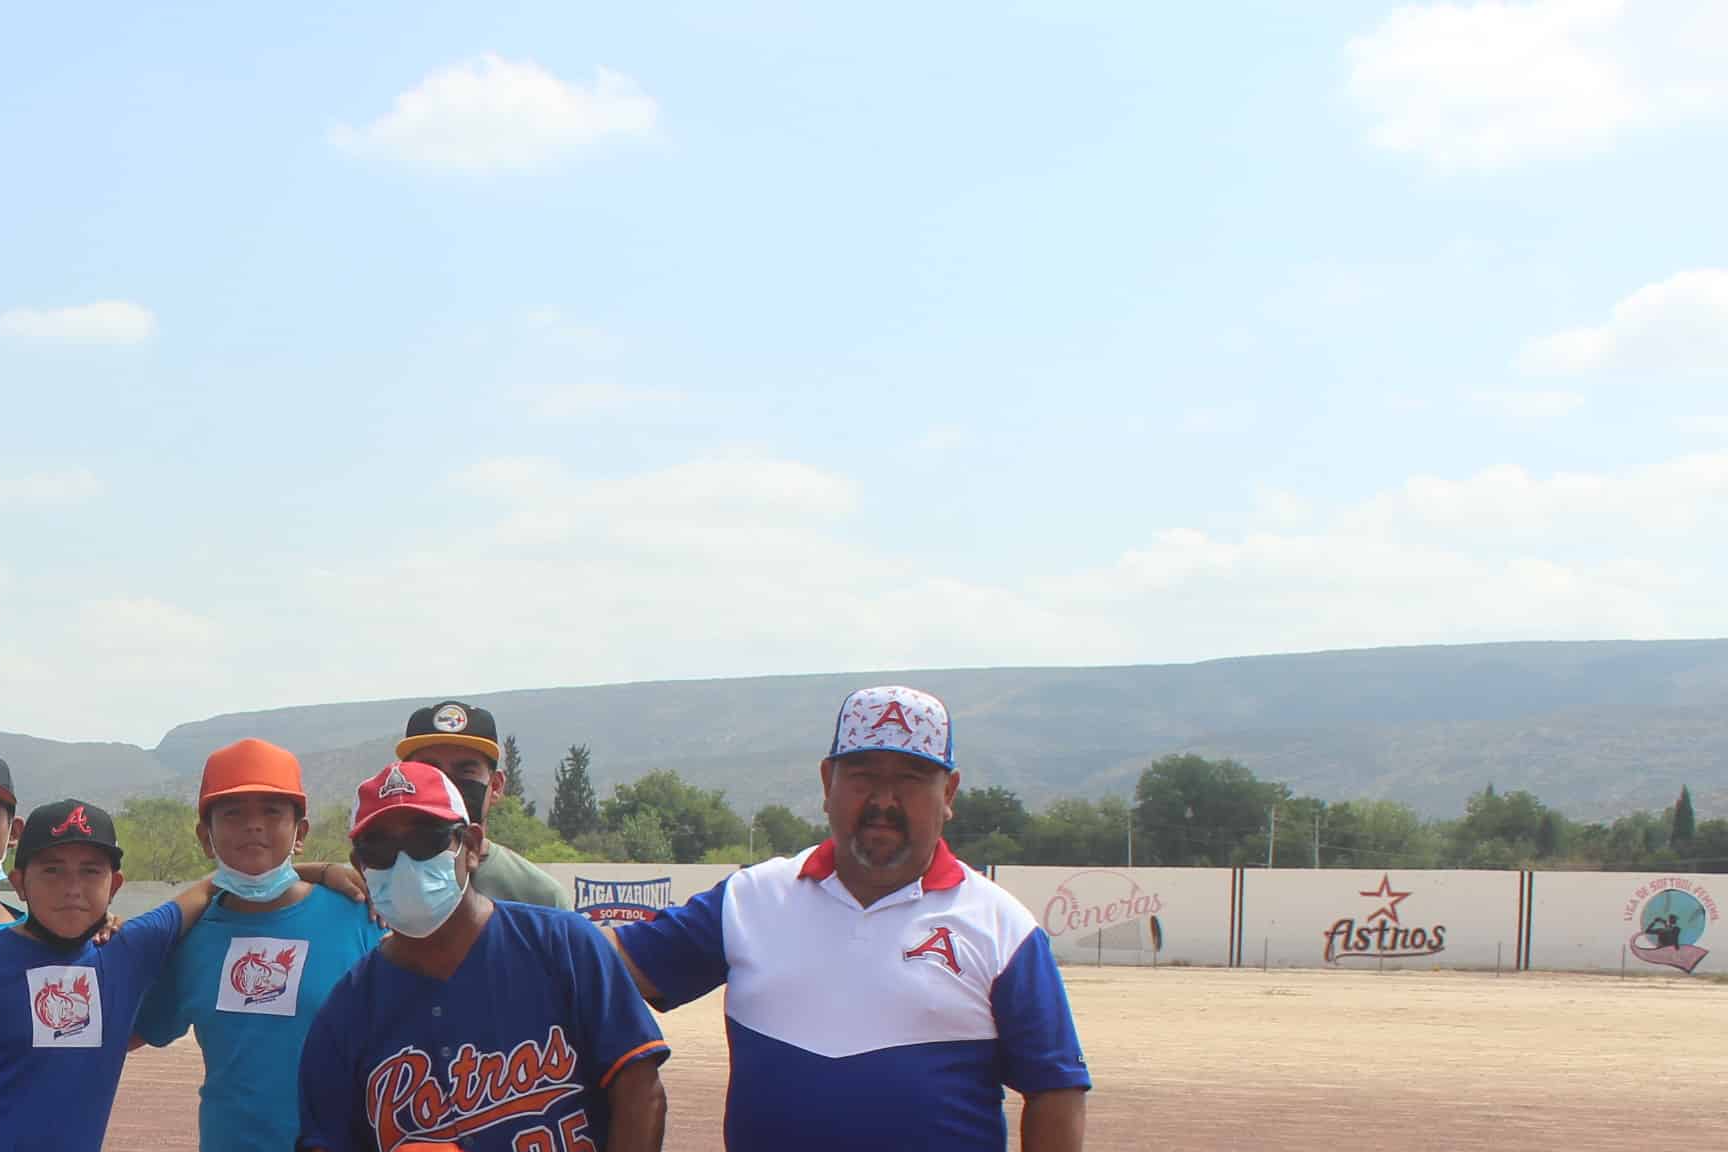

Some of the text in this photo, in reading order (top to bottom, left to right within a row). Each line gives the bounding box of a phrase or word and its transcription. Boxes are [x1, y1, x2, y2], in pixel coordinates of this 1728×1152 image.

[872, 700, 913, 734] A
[51, 805, 94, 836] A
[577, 881, 613, 909] LIGA
[599, 908, 647, 921] SOFTBOL
[902, 926, 965, 977] A
[1323, 918, 1446, 962] Astros
